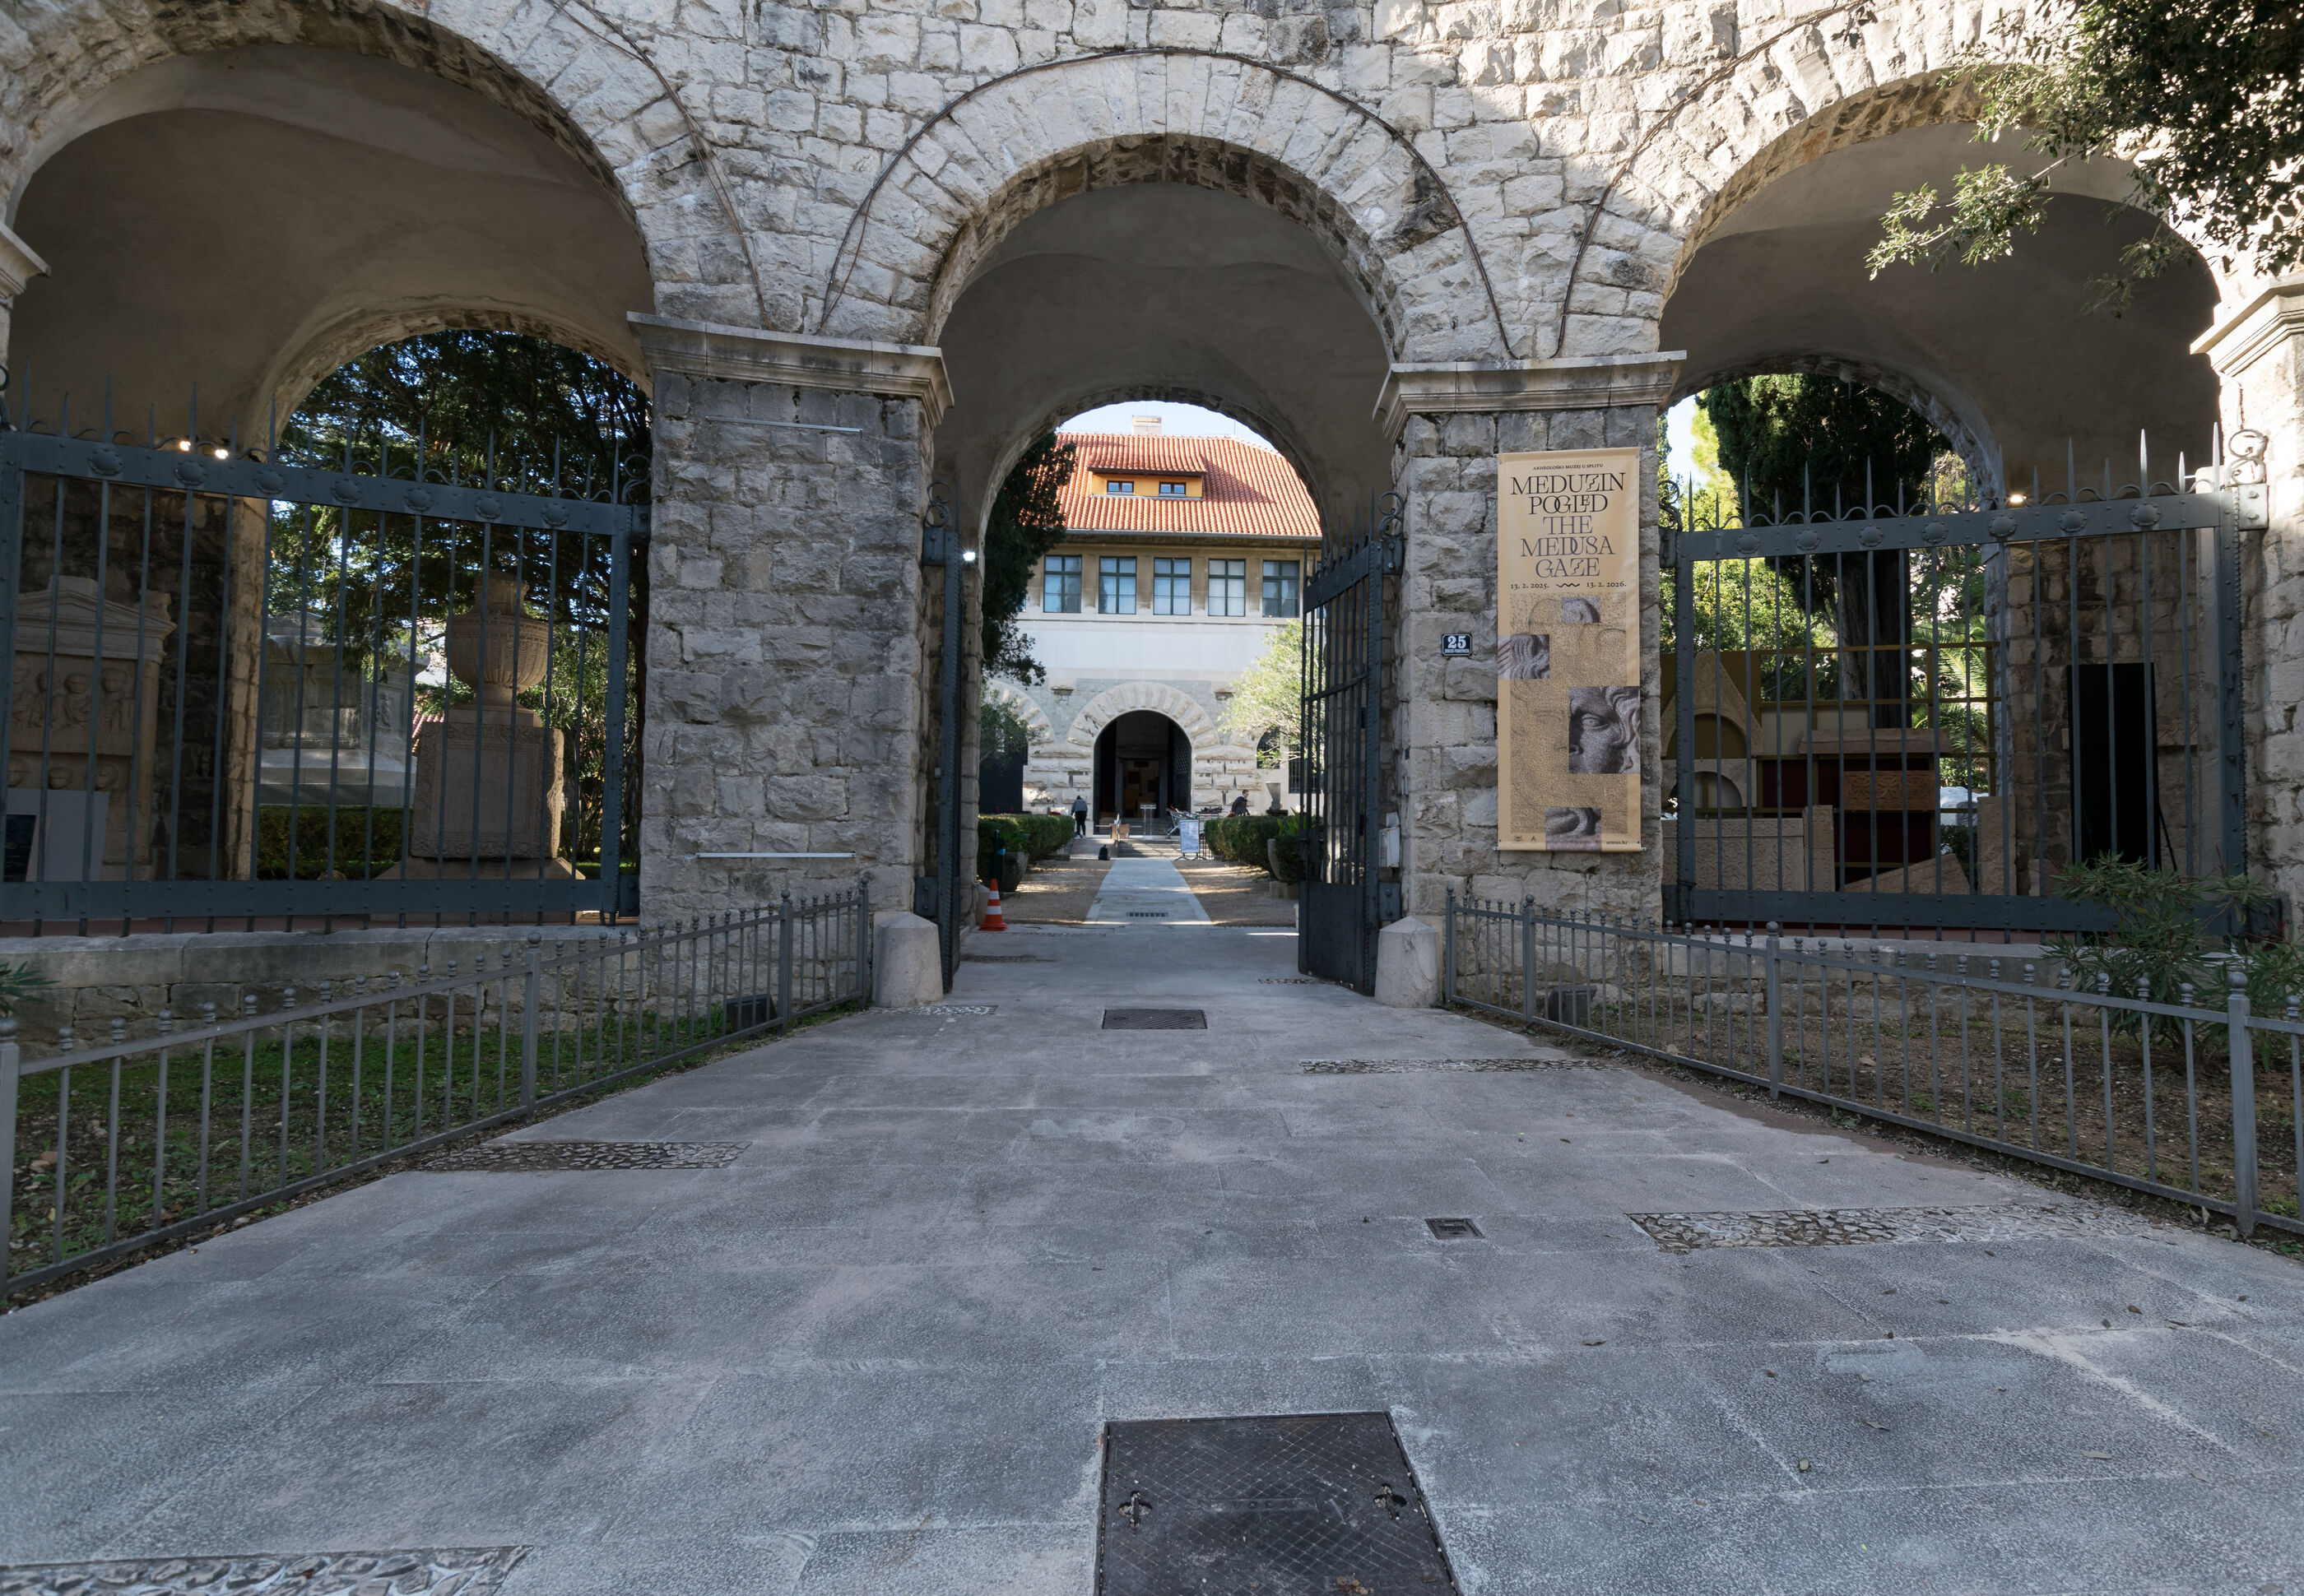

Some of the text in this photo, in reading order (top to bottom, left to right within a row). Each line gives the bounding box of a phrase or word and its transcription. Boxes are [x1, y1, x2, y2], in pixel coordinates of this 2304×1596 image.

[1511, 472, 1626, 495] MEDUZIN
[1528, 494, 1608, 515] POGLED
[1543, 515, 1593, 536] THE
[1521, 536, 1616, 557] MEDUSA
[1535, 557, 1600, 578] GAZE
[1447, 635, 1466, 649] 25
